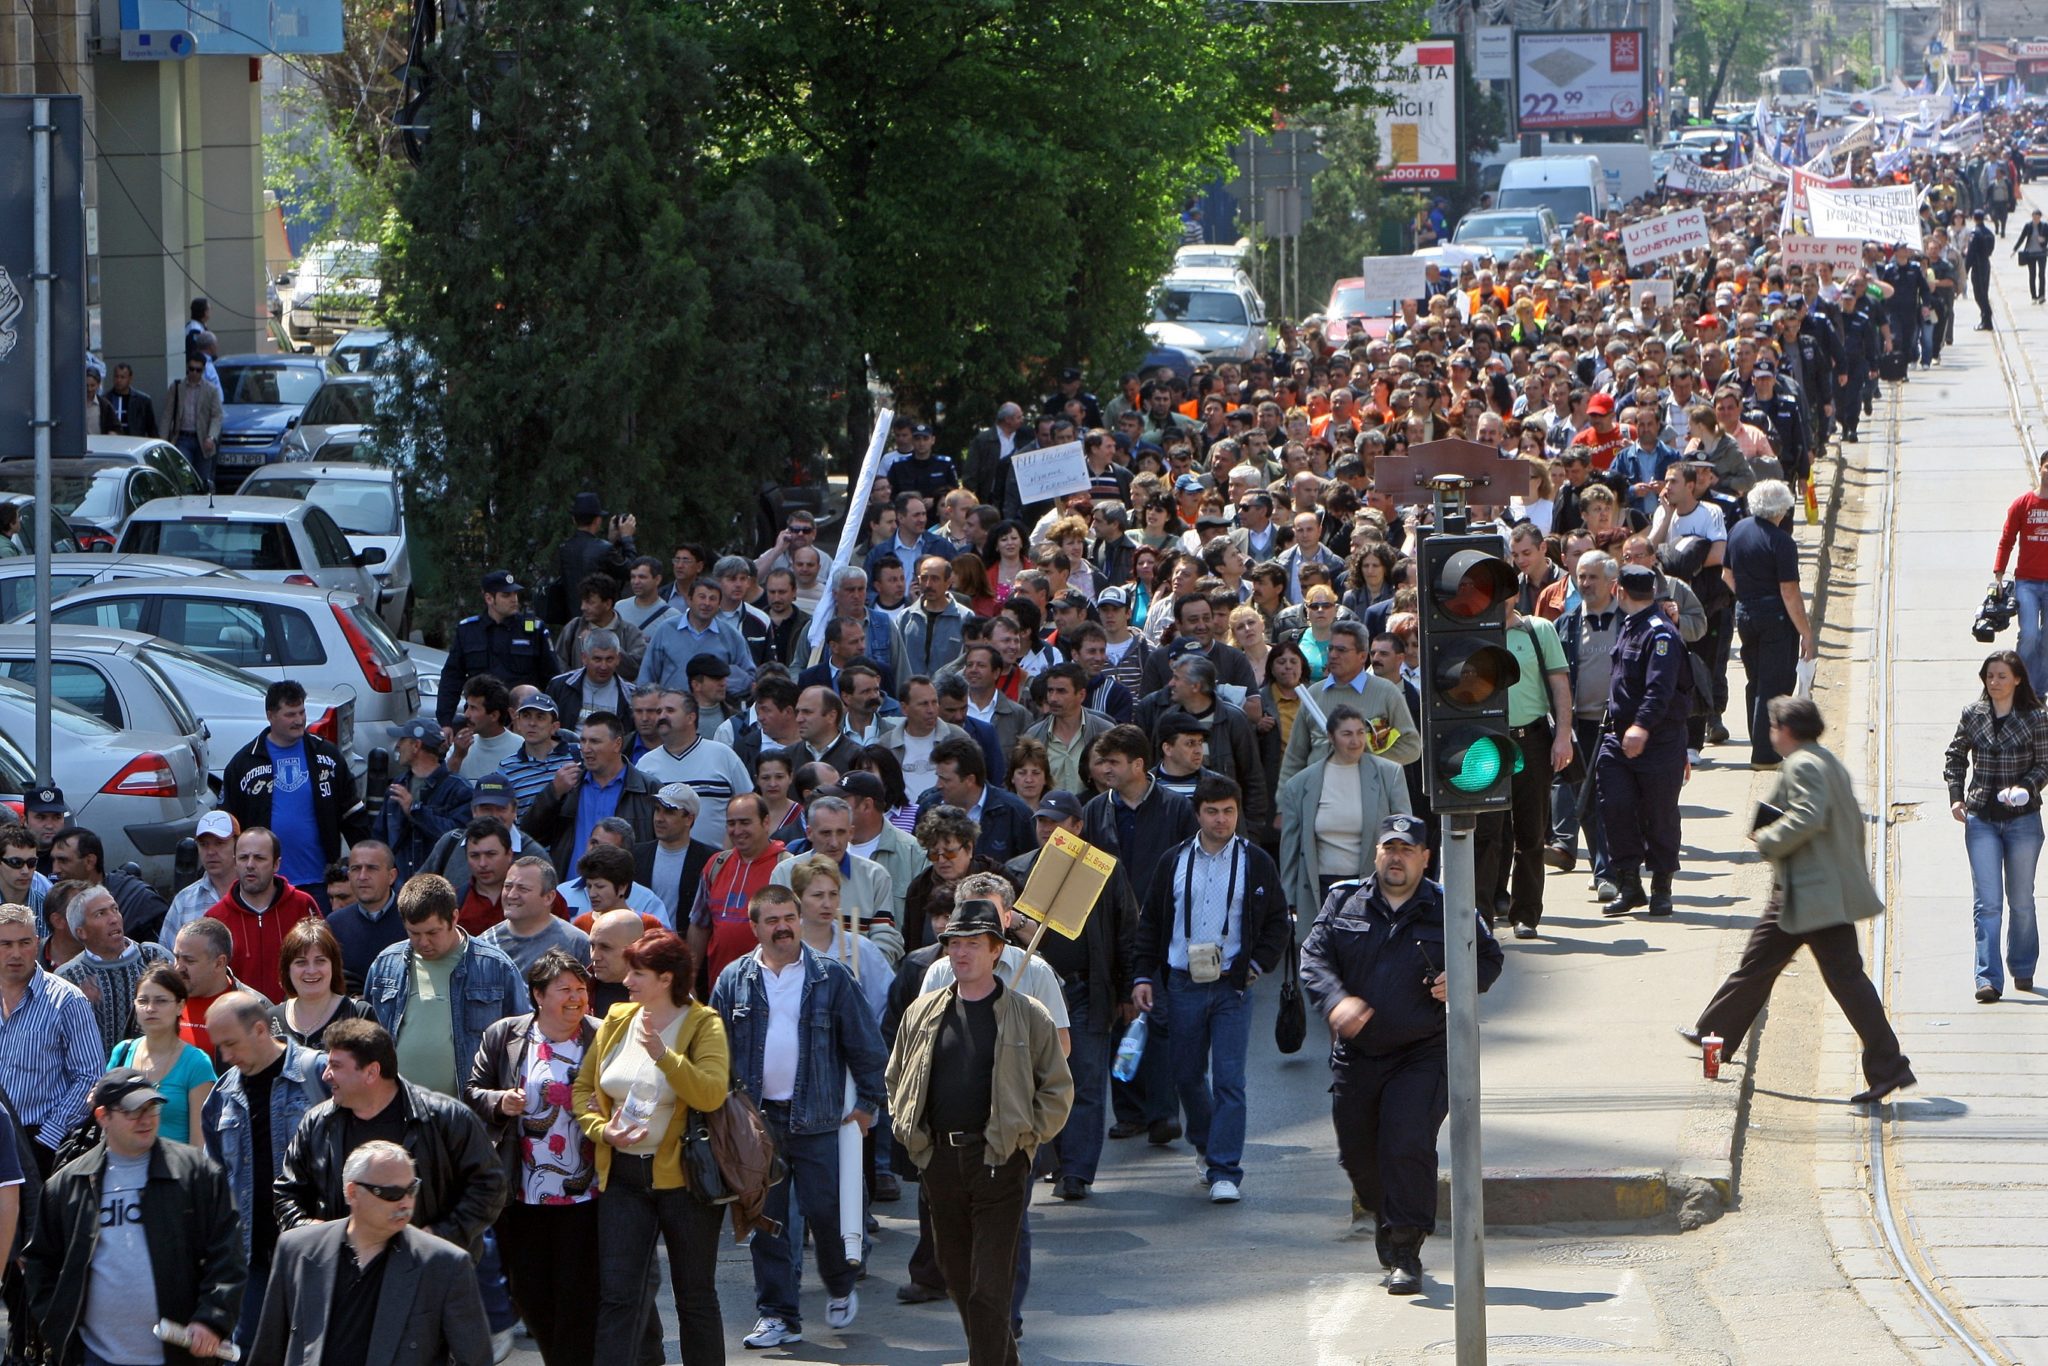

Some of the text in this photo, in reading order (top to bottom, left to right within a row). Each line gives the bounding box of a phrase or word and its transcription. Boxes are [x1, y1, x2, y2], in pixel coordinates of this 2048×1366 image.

[1424, 65, 1448, 80] TA
[1386, 102, 1422, 117] AICI
[319, 782, 332, 797] 50
